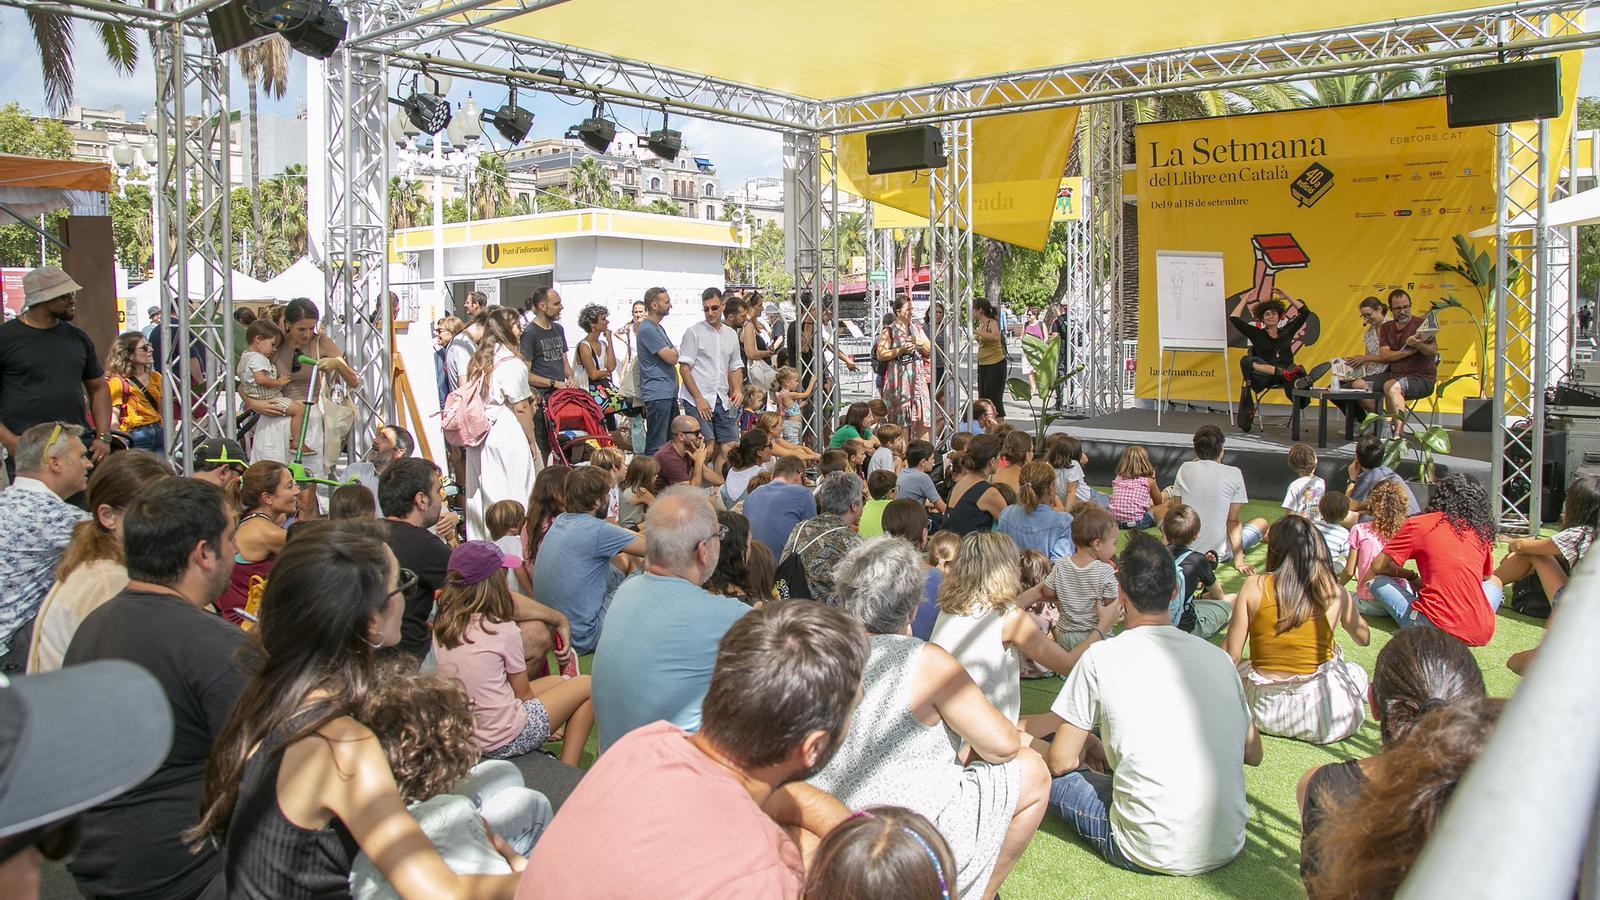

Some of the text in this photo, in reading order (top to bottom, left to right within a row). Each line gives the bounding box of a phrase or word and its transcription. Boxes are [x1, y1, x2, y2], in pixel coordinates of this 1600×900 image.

[1150, 137, 1328, 168] La Setmana
[1149, 165, 1289, 187] del Llibre en Català
[1151, 197, 1249, 209] Del 9 al 18 de setembre
